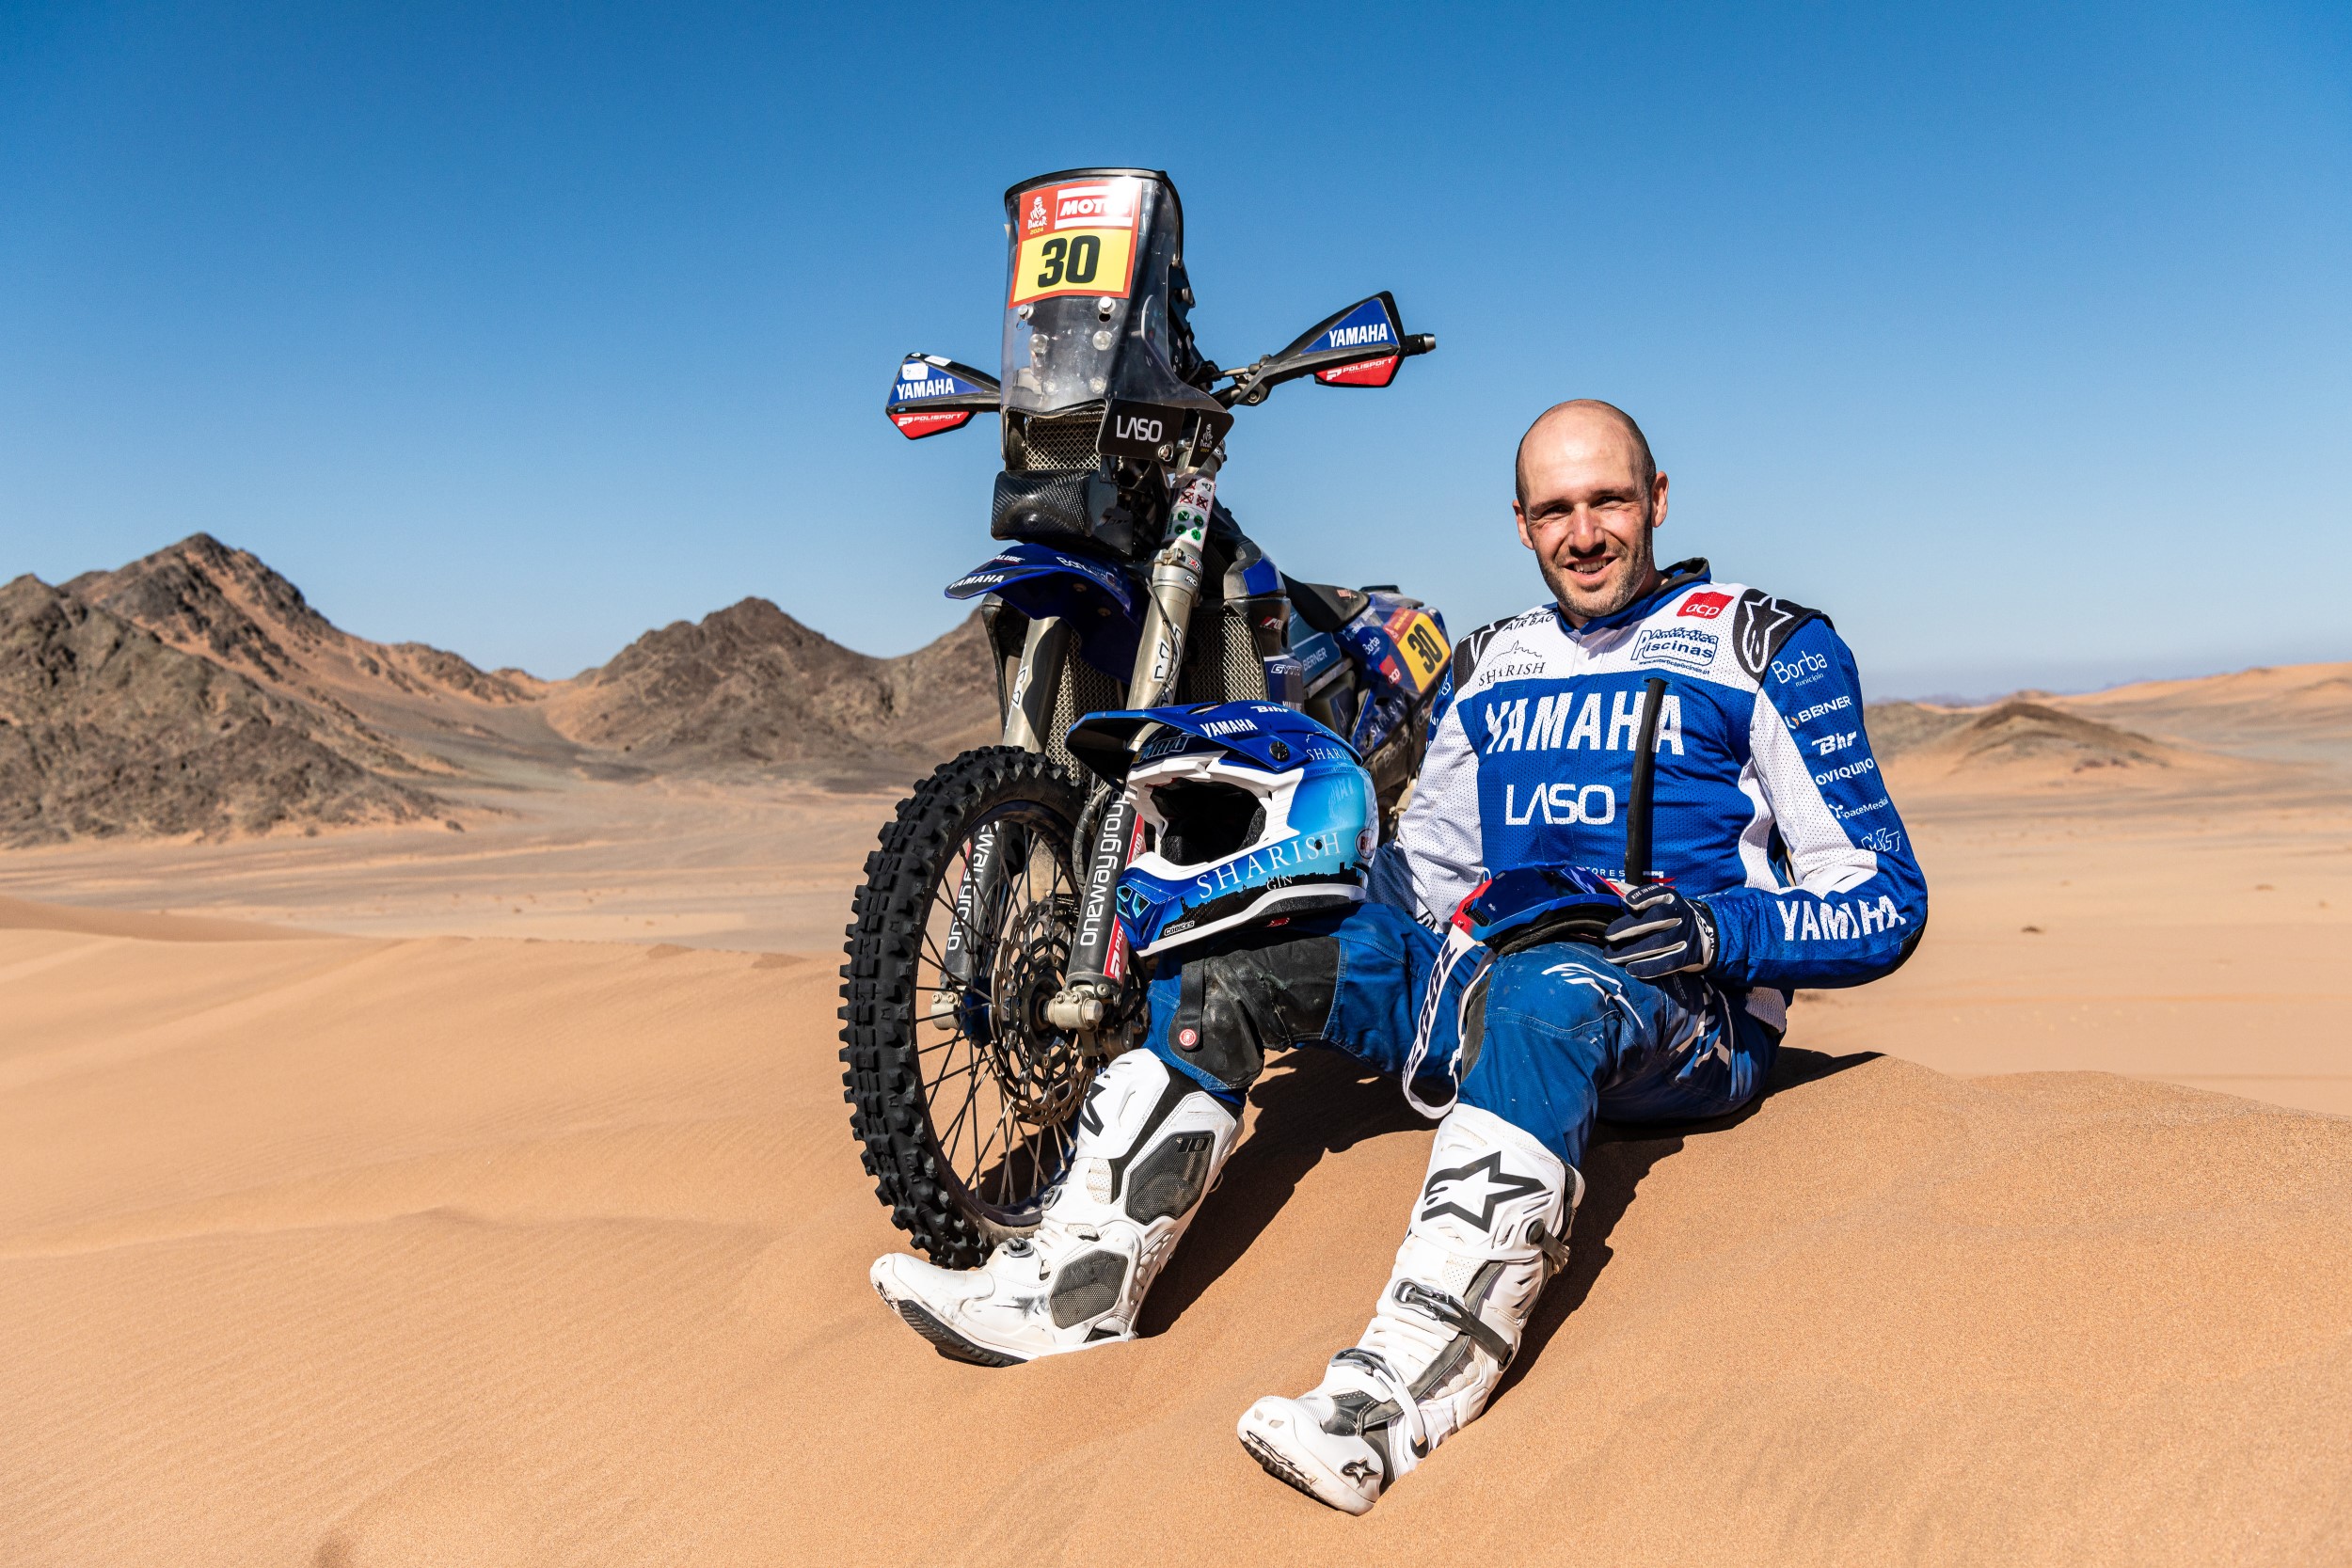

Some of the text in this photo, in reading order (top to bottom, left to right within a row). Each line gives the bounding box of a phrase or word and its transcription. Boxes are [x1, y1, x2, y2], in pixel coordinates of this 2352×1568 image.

[1027, 216, 1047, 230] DAKAR
[1038, 235, 1101, 288] 30
[1328, 324, 1388, 348] YAMAHA
[1343, 357, 1393, 373] POLISPORT
[897, 378, 955, 400] YAMAHA
[914, 413, 961, 422] POLISPORT
[1116, 415, 1163, 443] LASO
[948, 575, 1005, 590] YAMAHA
[1685, 603, 1721, 617] acp
[1502, 619, 1528, 632] AIR
[1528, 614, 1555, 626] BAG
[1363, 636, 1381, 656] Borba
[1406, 623, 1444, 674] 30
[1630, 630, 1714, 661] Piscinas
[1303, 647, 1328, 672] BERNER
[1771, 650, 1828, 684] Borba
[1478, 662, 1547, 687] SHARISH
[1250, 705, 1289, 714] Bihr
[1798, 695, 1852, 723] BERNER
[1200, 719, 1258, 738] YAMAHA
[1485, 691, 1685, 755] YAMAHA
[1811, 731, 1857, 756] Bhr
[1505, 783, 1615, 826] LASO
[1197, 832, 1342, 899] SHARISH
[1265, 874, 1293, 892] GIN
[1775, 895, 1907, 942] YAMAHA
